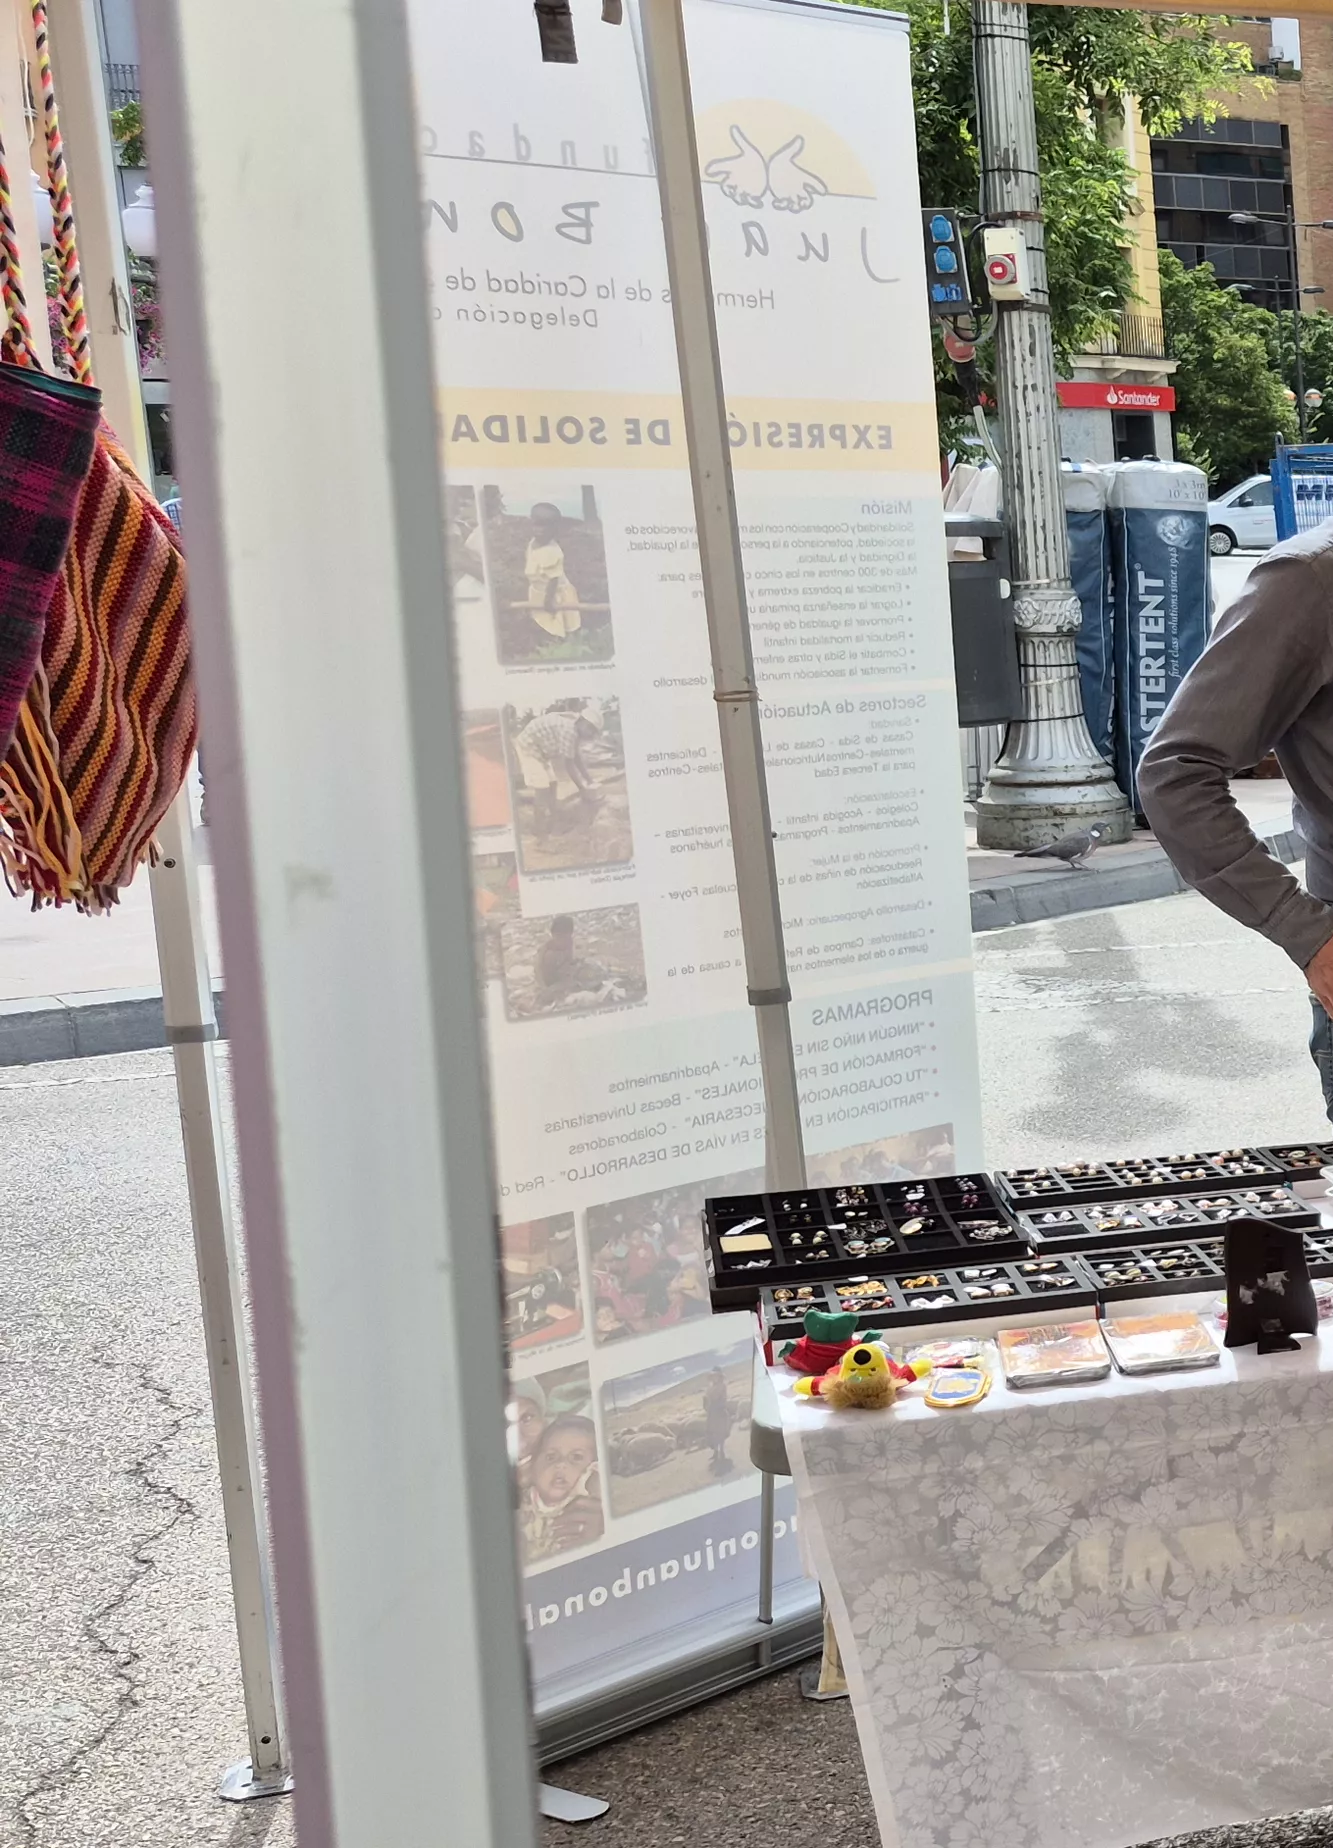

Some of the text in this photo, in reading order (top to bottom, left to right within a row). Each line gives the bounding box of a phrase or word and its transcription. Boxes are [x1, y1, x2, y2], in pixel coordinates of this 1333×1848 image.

[1117, 390, 1160, 406] Santander
[1191, 480, 1206, 488] 3m
[1168, 547, 1182, 679] first class solutions since 1948
